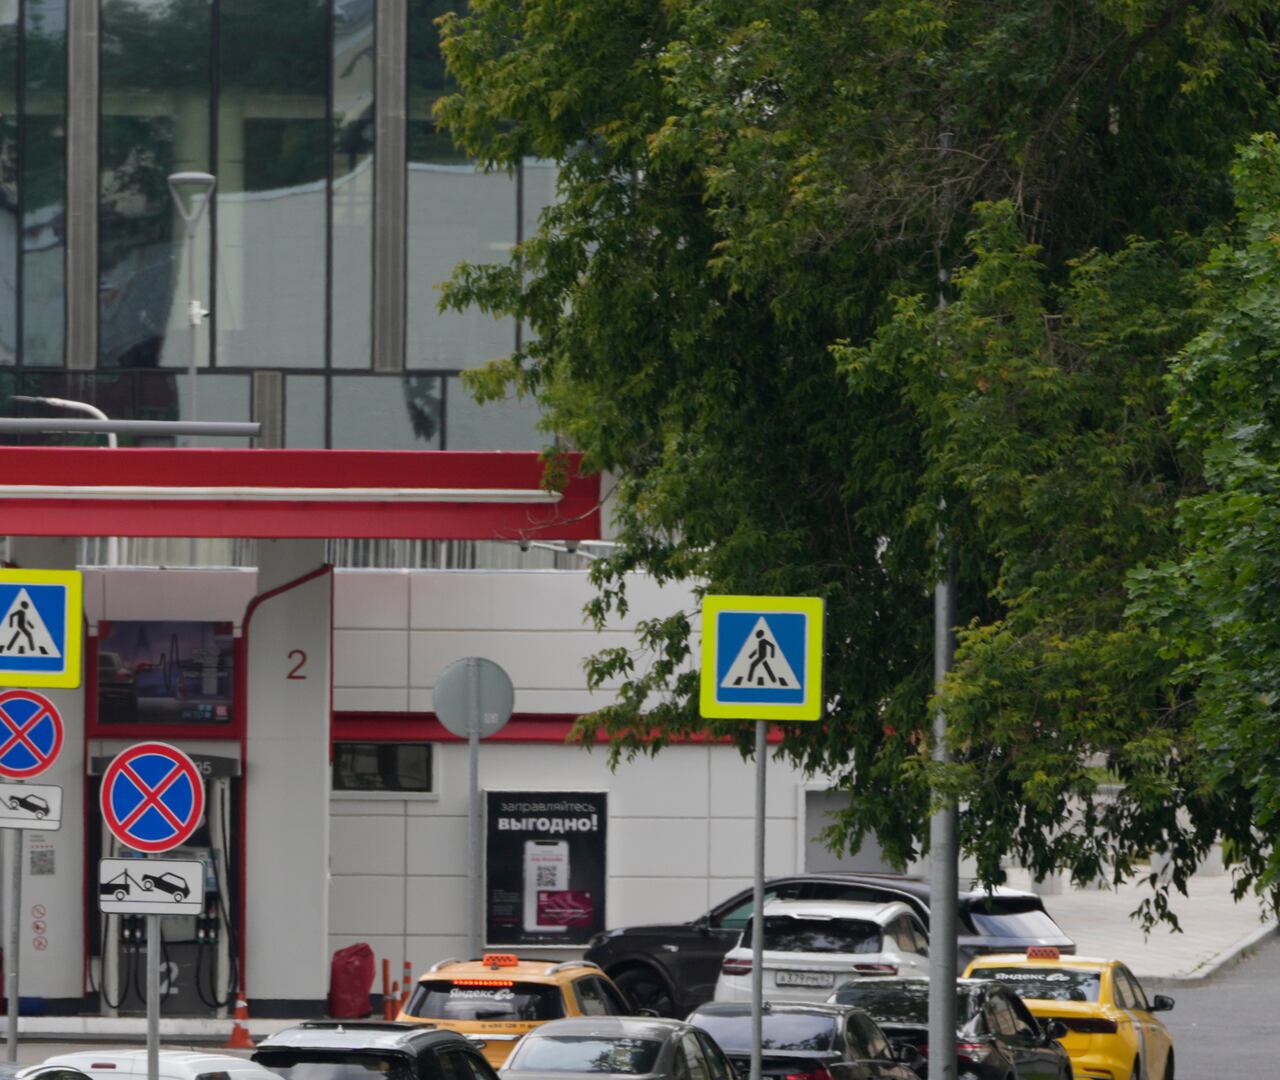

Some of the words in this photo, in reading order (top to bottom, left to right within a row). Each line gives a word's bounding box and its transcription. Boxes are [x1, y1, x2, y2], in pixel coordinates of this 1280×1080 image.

[286, 649, 307, 679] 2
[501, 801, 597, 813] заправляйтесь
[498, 814, 598, 834] выгодно!
[449, 988, 494, 998] Яндекс
